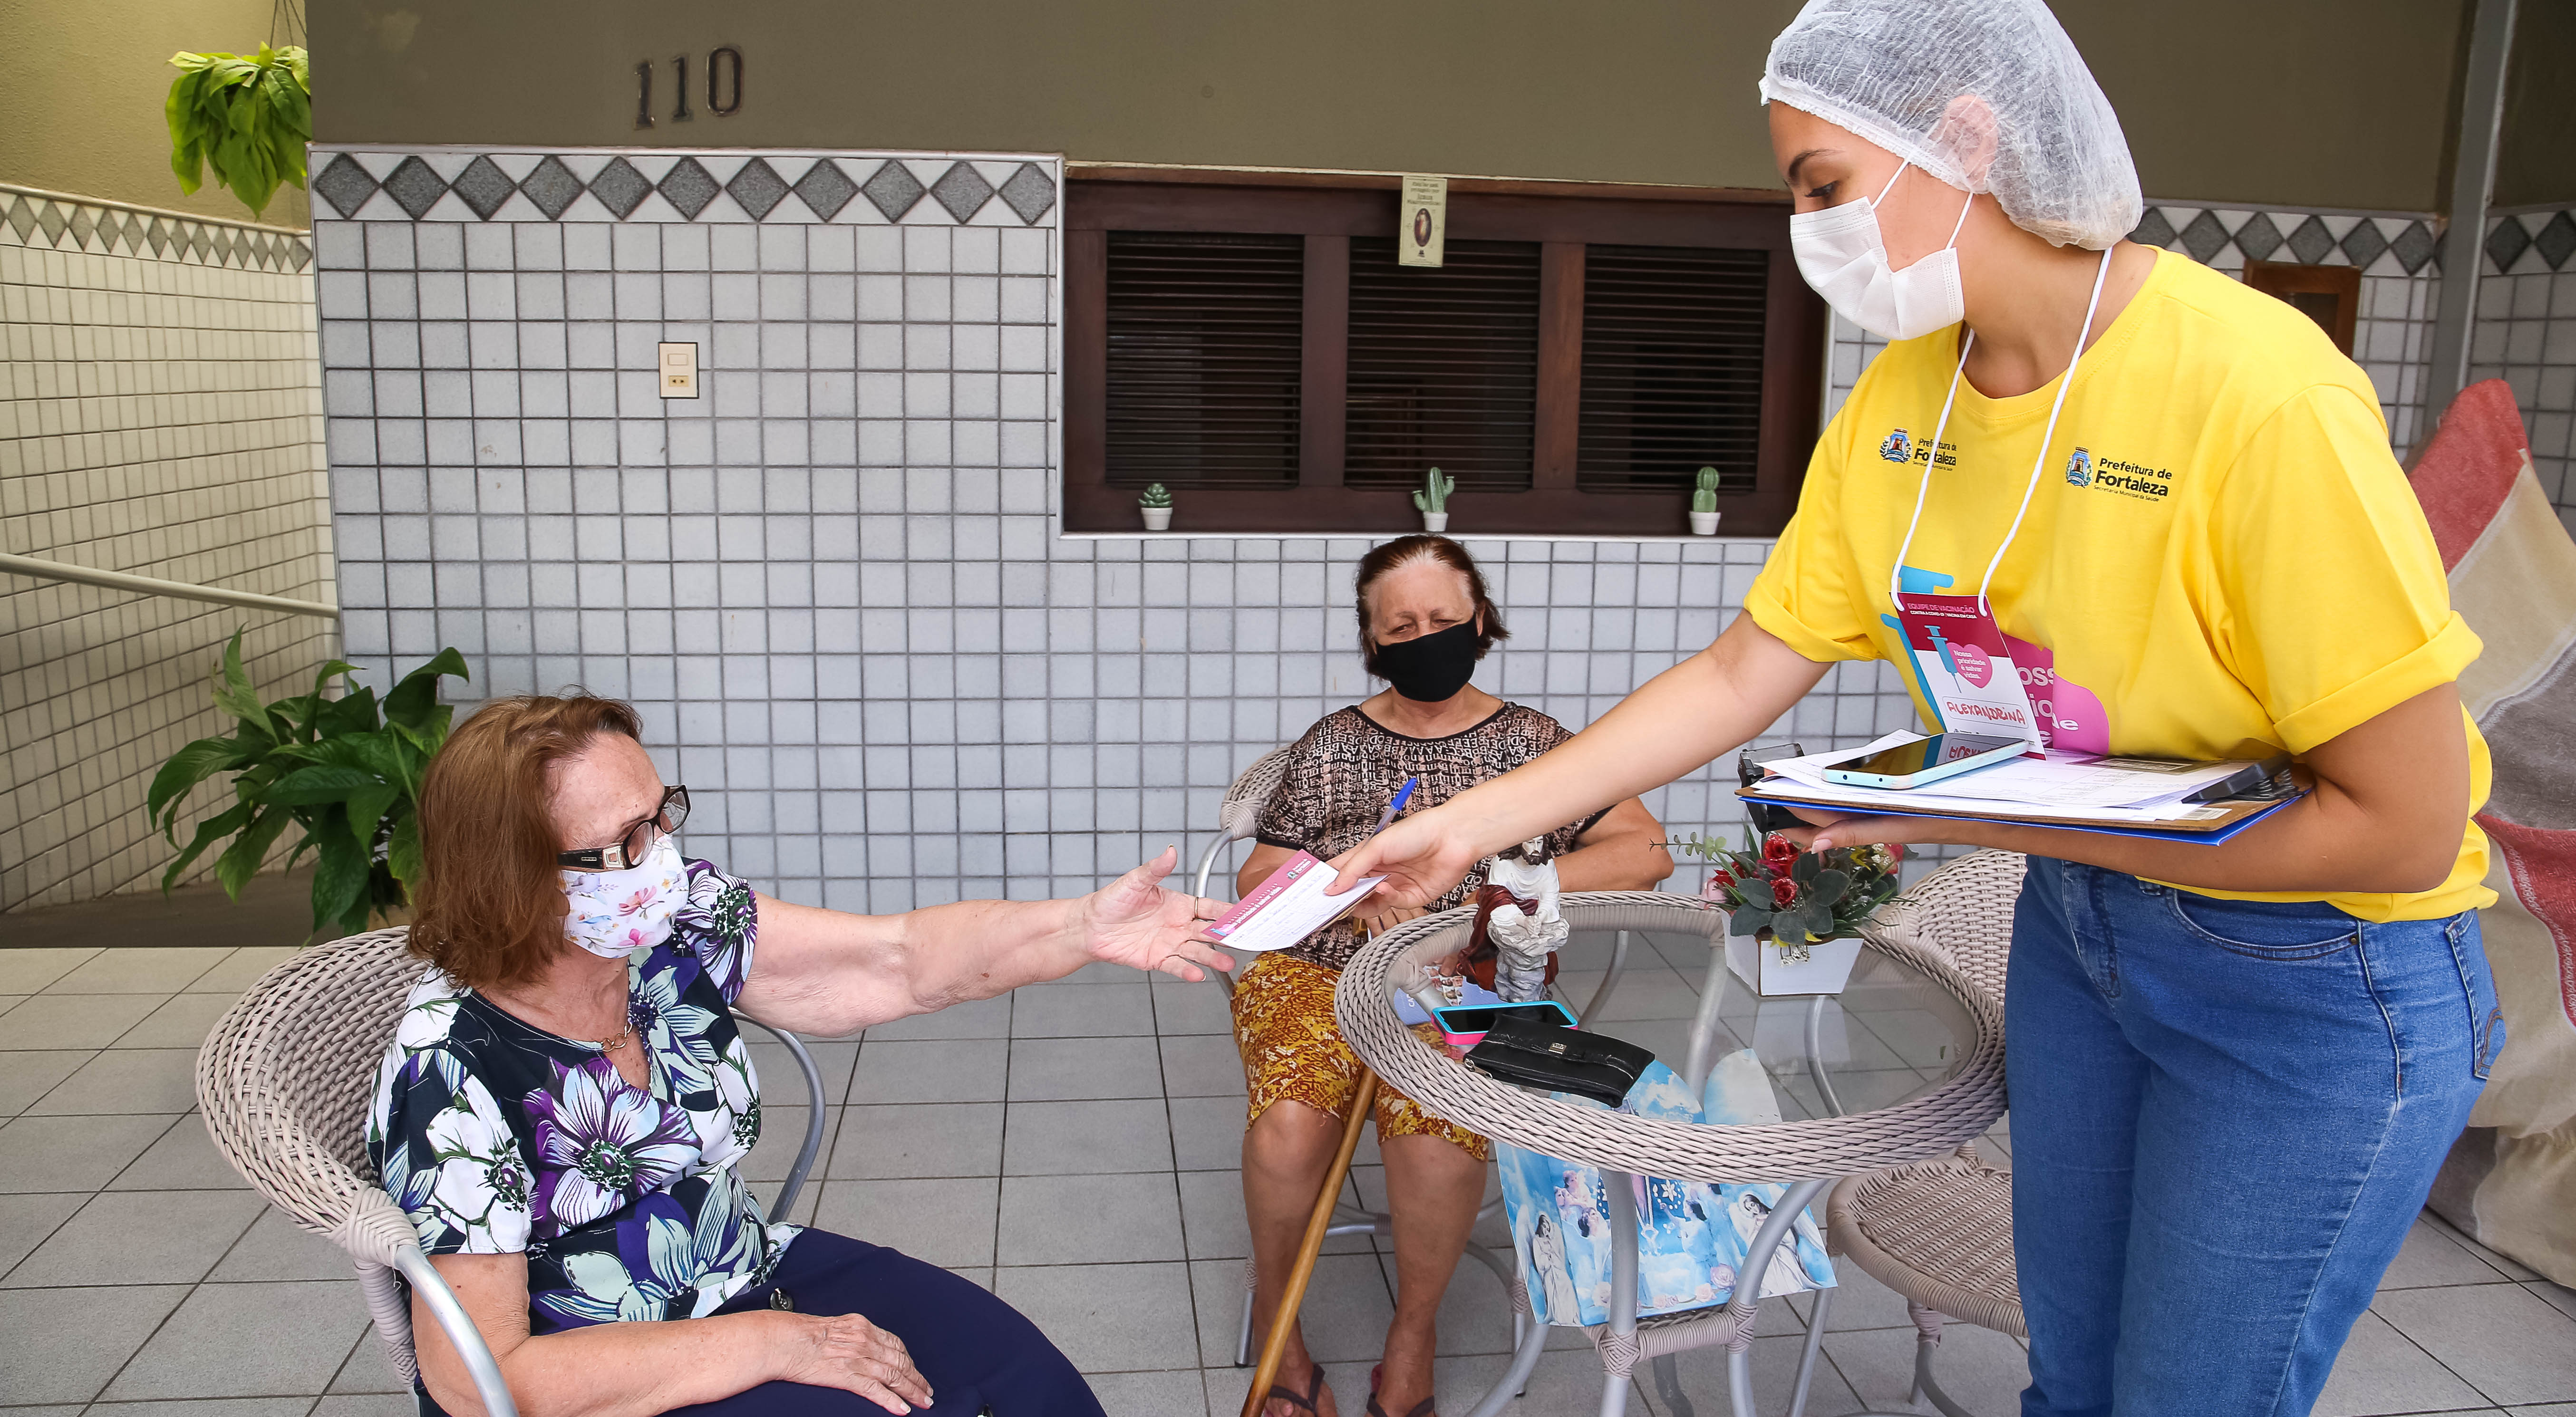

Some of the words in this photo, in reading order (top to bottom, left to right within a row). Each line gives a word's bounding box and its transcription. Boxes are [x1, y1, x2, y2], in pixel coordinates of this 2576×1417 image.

[634, 47, 742, 130] 110
[1918, 438, 1950, 450] Preftura
[1914, 448, 1956, 466] Fotaleza
[2100, 458, 2154, 476] Prefeitura
[2157, 469, 2172, 479] de
[2095, 470, 2169, 496] Fortaleza
[1938, 605, 1975, 614] VACINAÇÃO
